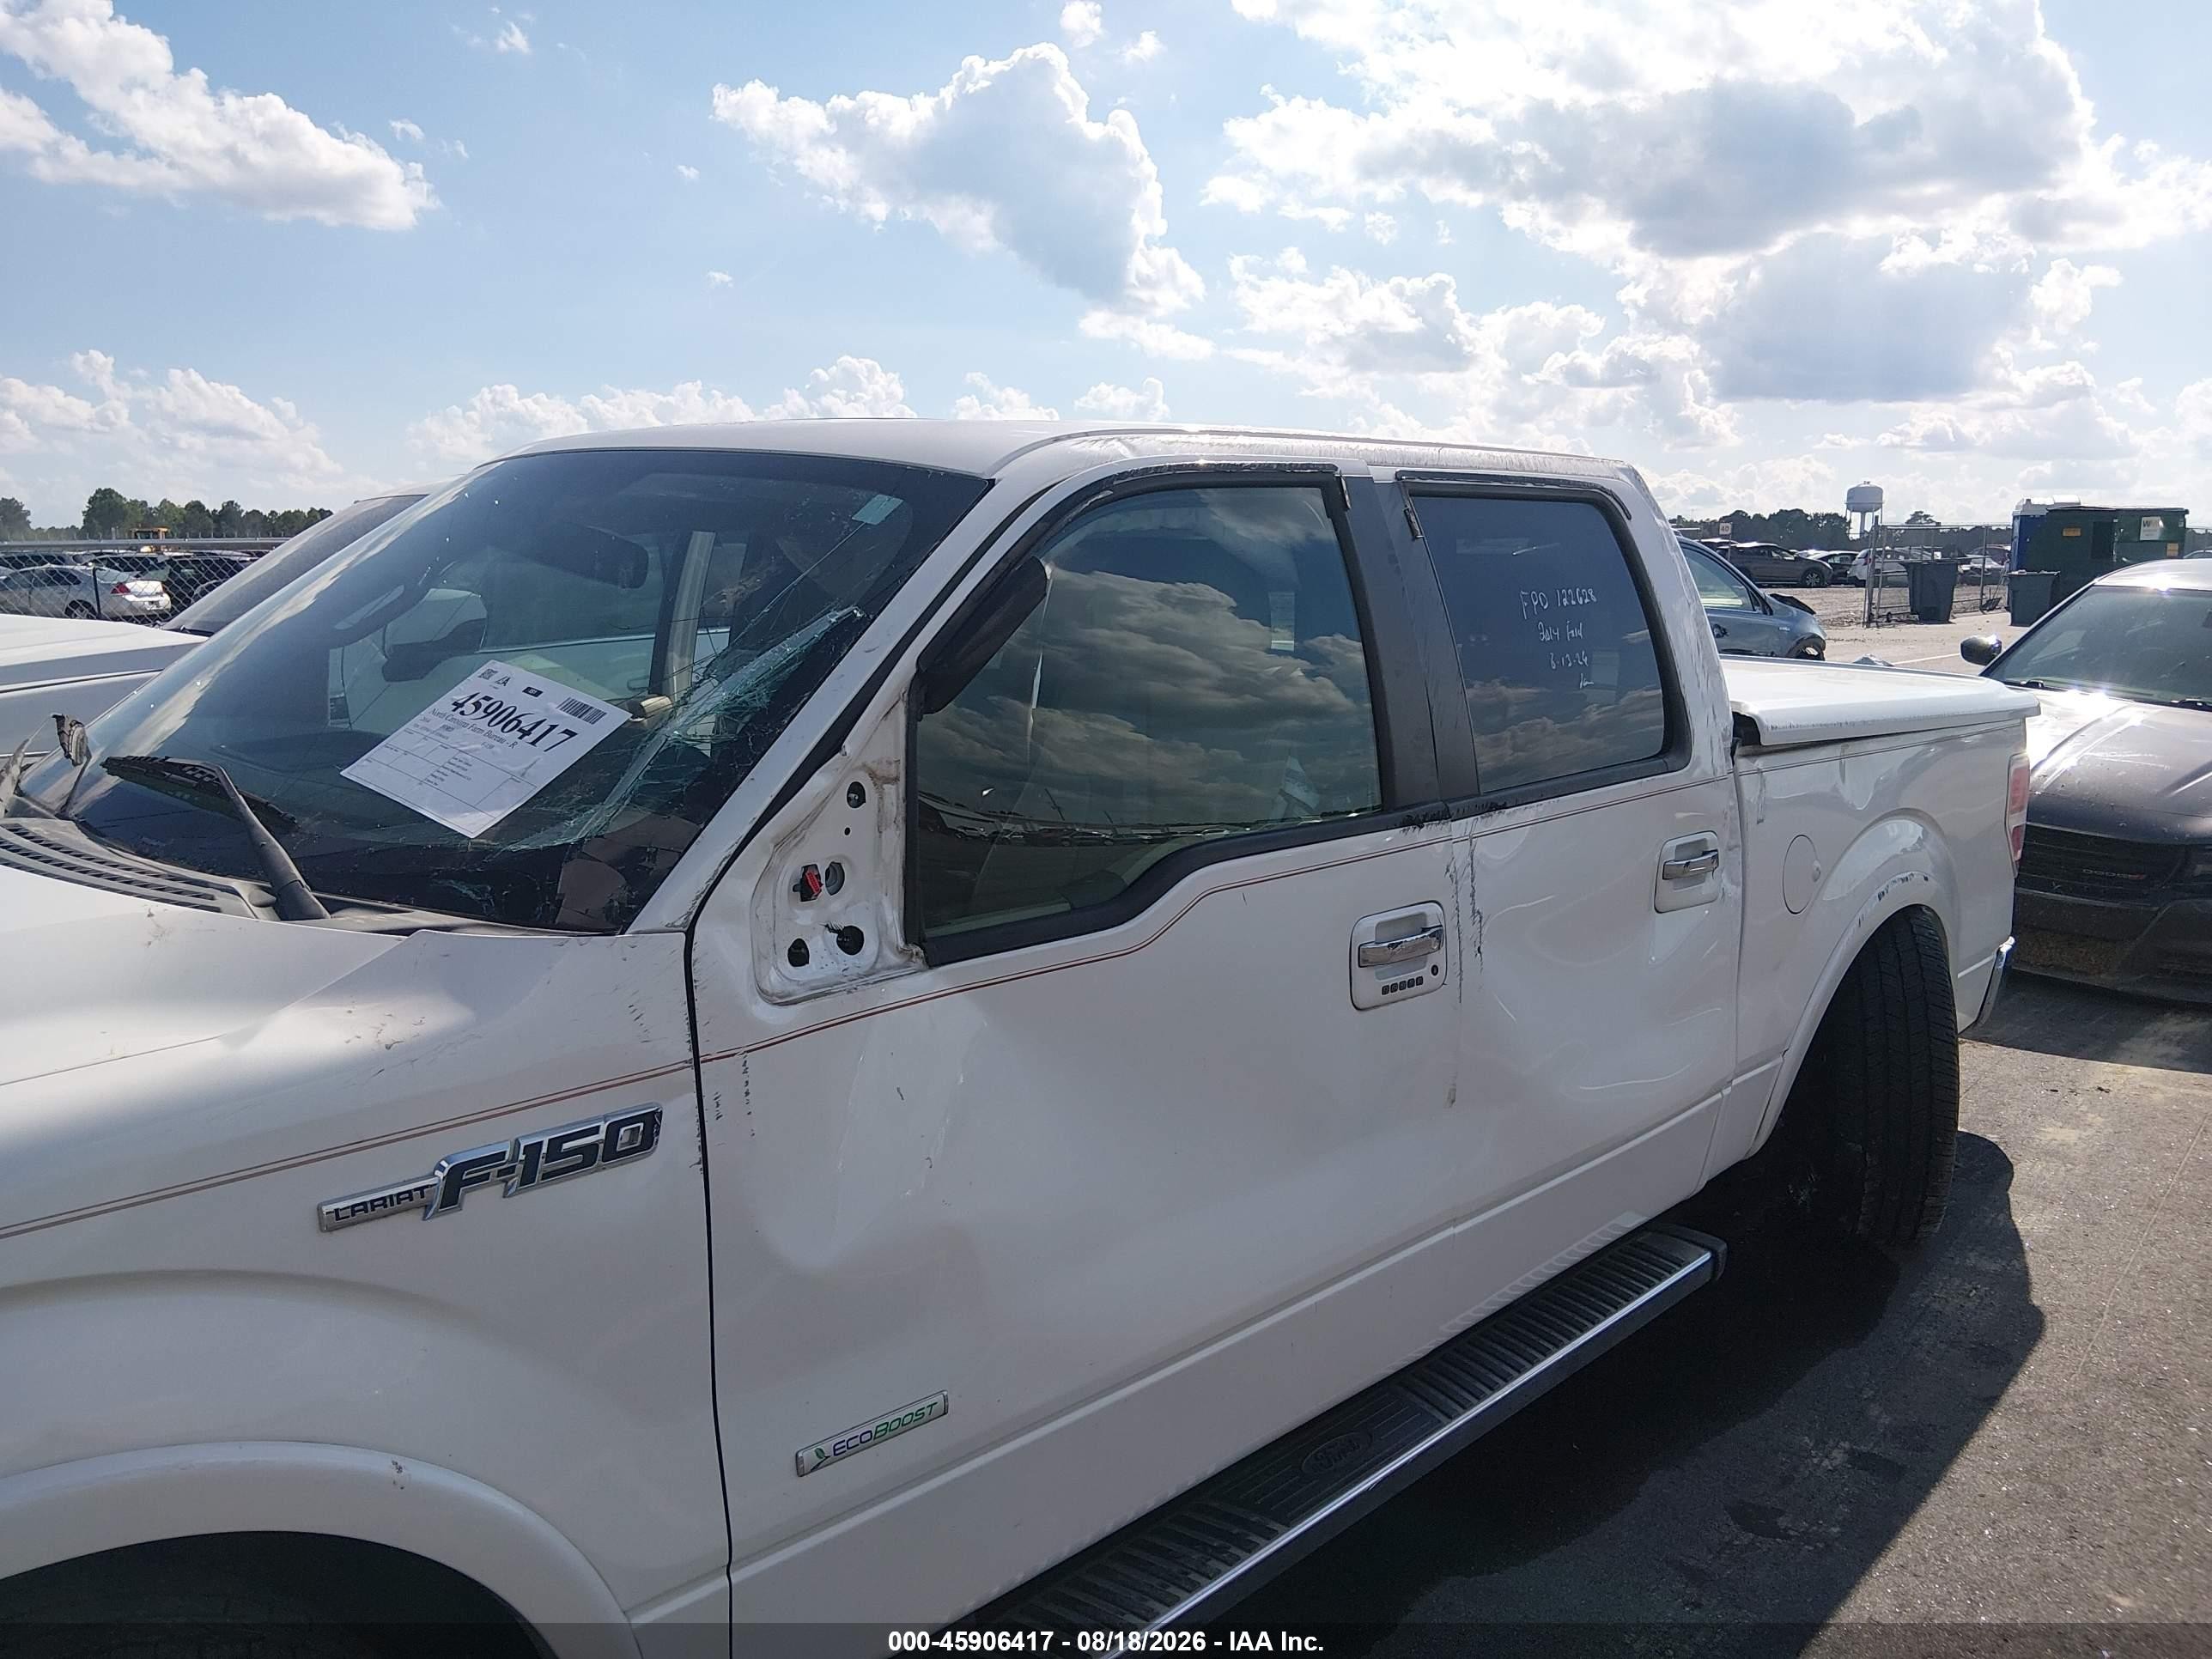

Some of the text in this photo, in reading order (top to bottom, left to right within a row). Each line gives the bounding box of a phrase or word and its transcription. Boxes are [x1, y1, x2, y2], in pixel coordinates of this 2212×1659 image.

[451, 692, 577, 752] 45906417
[483, 729, 507, 744] Bureau
[333, 1103, 663, 1223] LARIAT F-150
[833, 1401, 939, 1456] ECOBOOST
